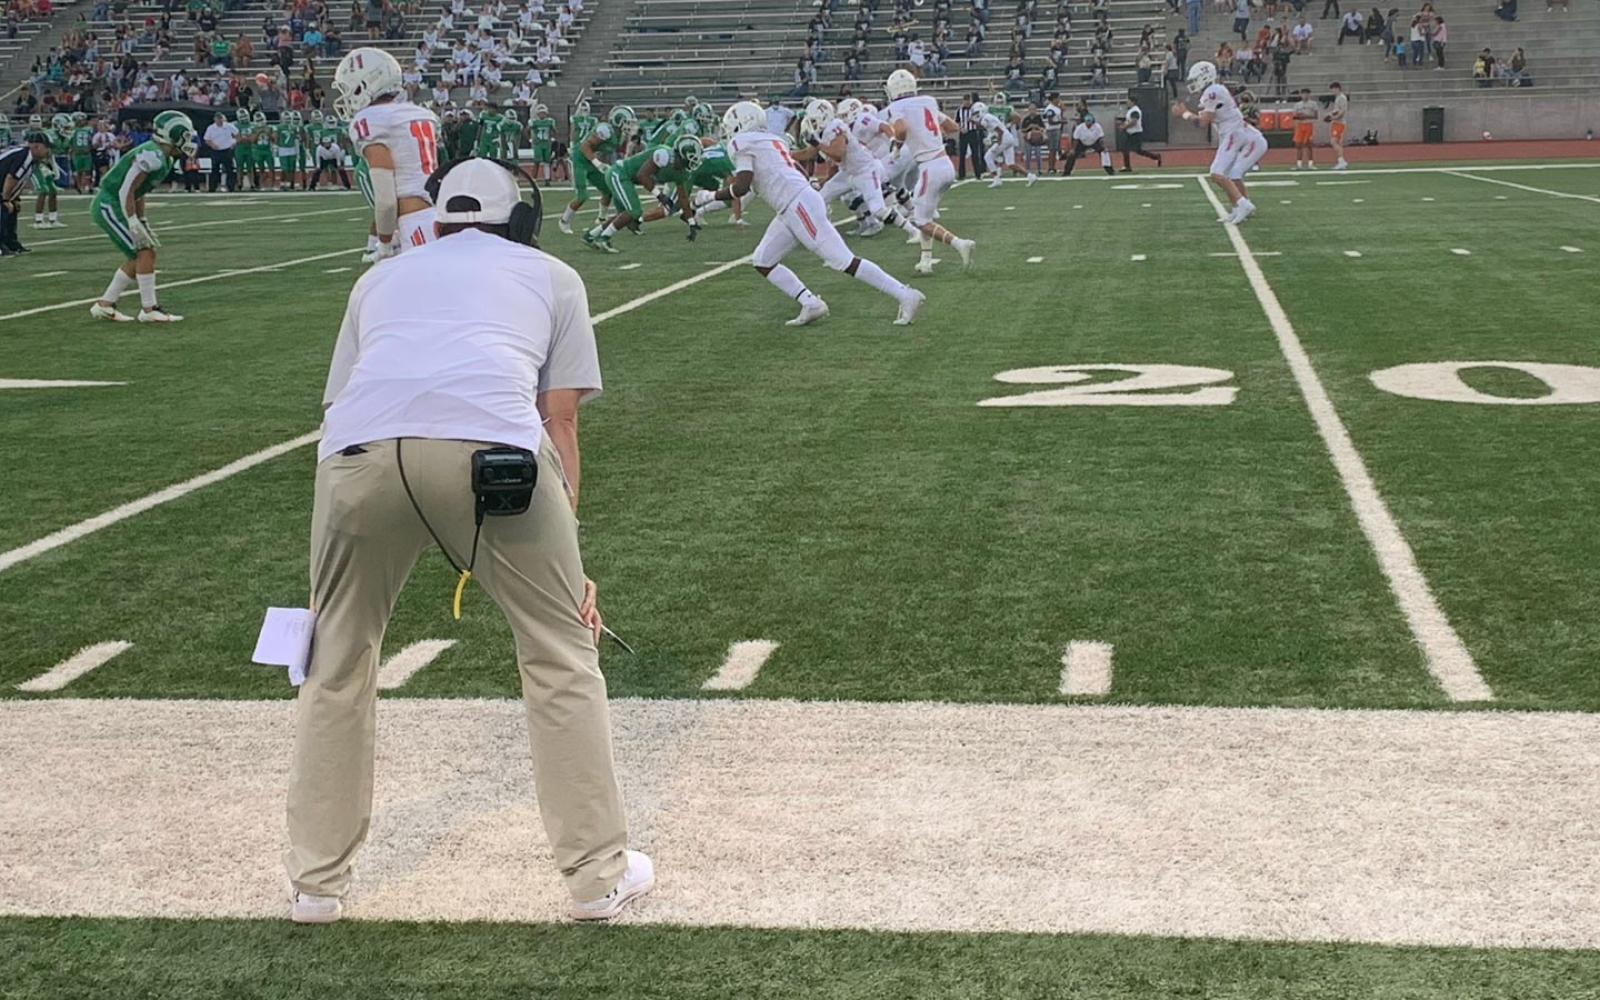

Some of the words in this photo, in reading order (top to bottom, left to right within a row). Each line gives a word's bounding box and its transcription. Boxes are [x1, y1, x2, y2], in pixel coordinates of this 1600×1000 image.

[354, 118, 370, 139] 11
[924, 107, 939, 136] 4
[410, 120, 438, 175] 11
